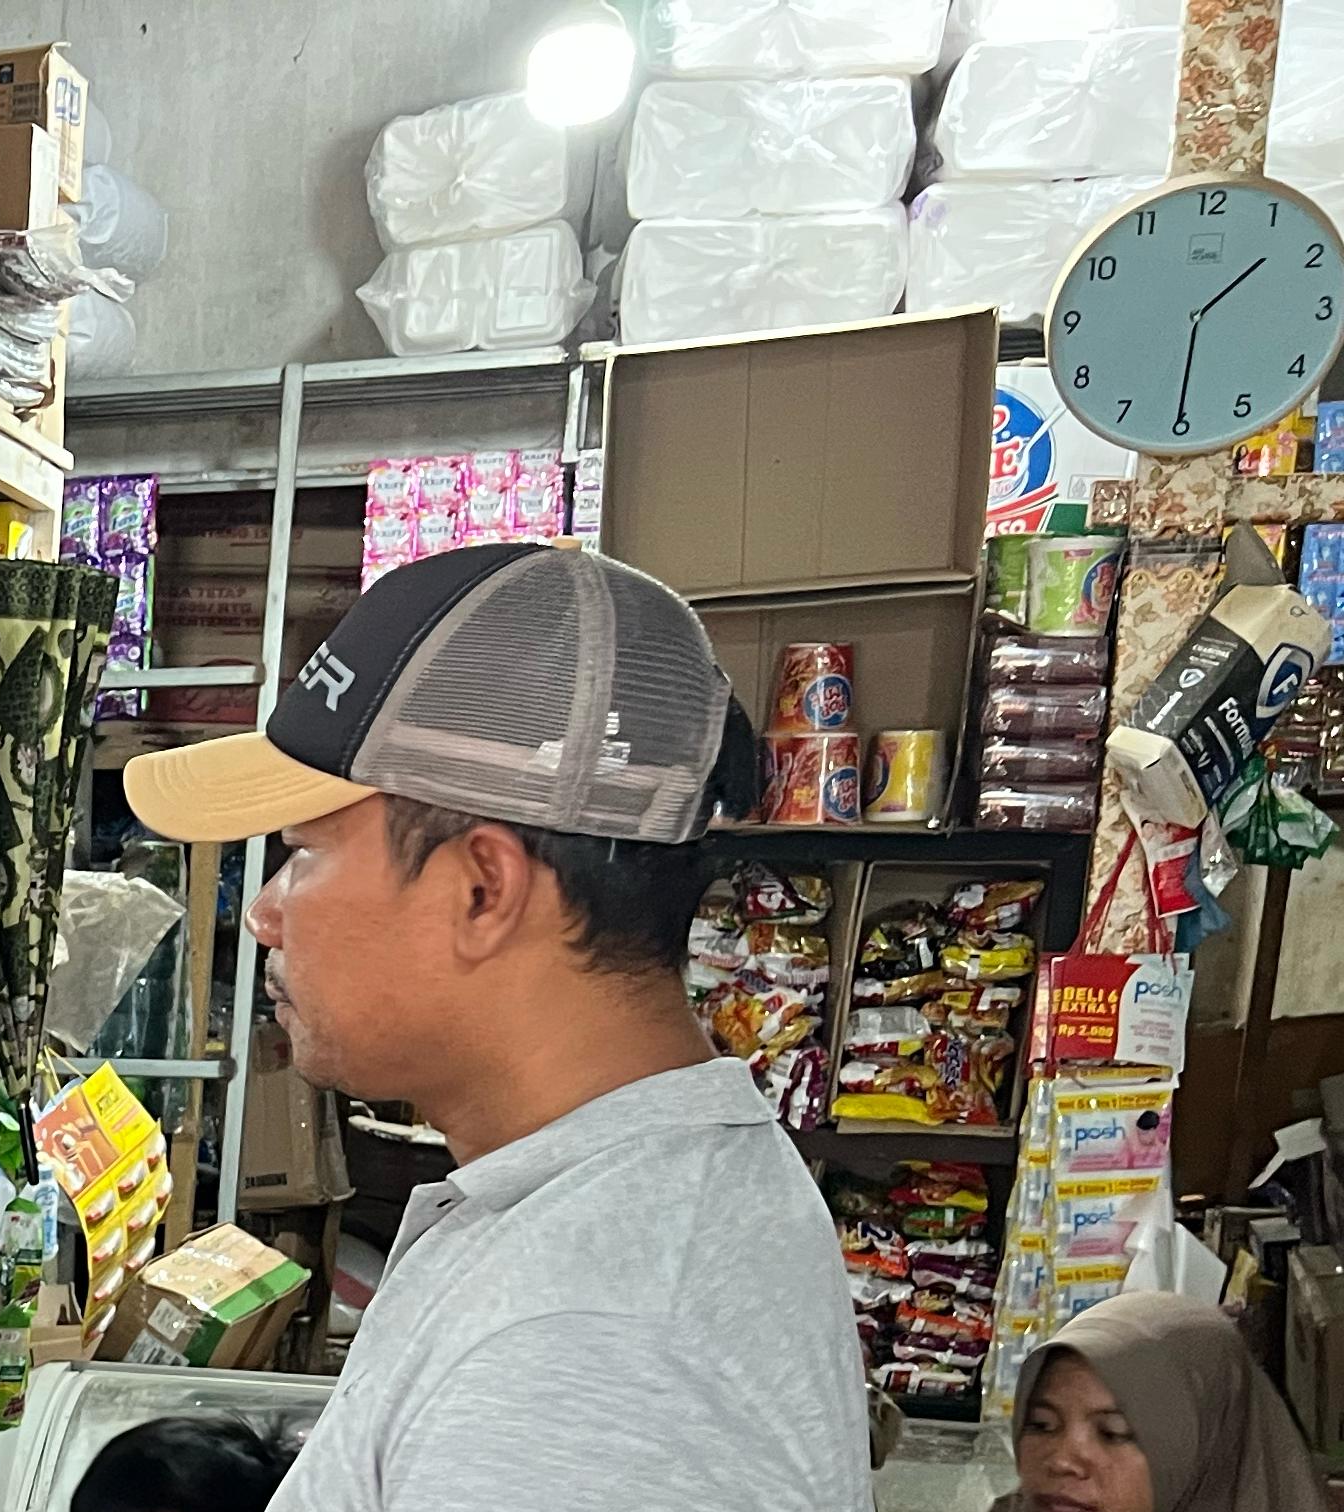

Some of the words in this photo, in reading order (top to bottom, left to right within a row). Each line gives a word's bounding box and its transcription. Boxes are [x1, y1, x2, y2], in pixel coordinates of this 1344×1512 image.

[1198, 190, 1227, 215] 12
[1267, 203, 1278, 227] 1
[1136, 211, 1156, 235] 11
[1305, 243, 1325, 268] 2
[1088, 256, 1116, 281] 10
[1315, 296, 1333, 321] 3
[1064, 310, 1081, 335] 9
[1074, 365, 1090, 389] 8
[1287, 354, 1305, 378] 4
[1117, 400, 1132, 423] 7
[1233, 393, 1252, 418] 5
[1172, 412, 1190, 436] 6
[1074, 1118, 1126, 1150] posh
